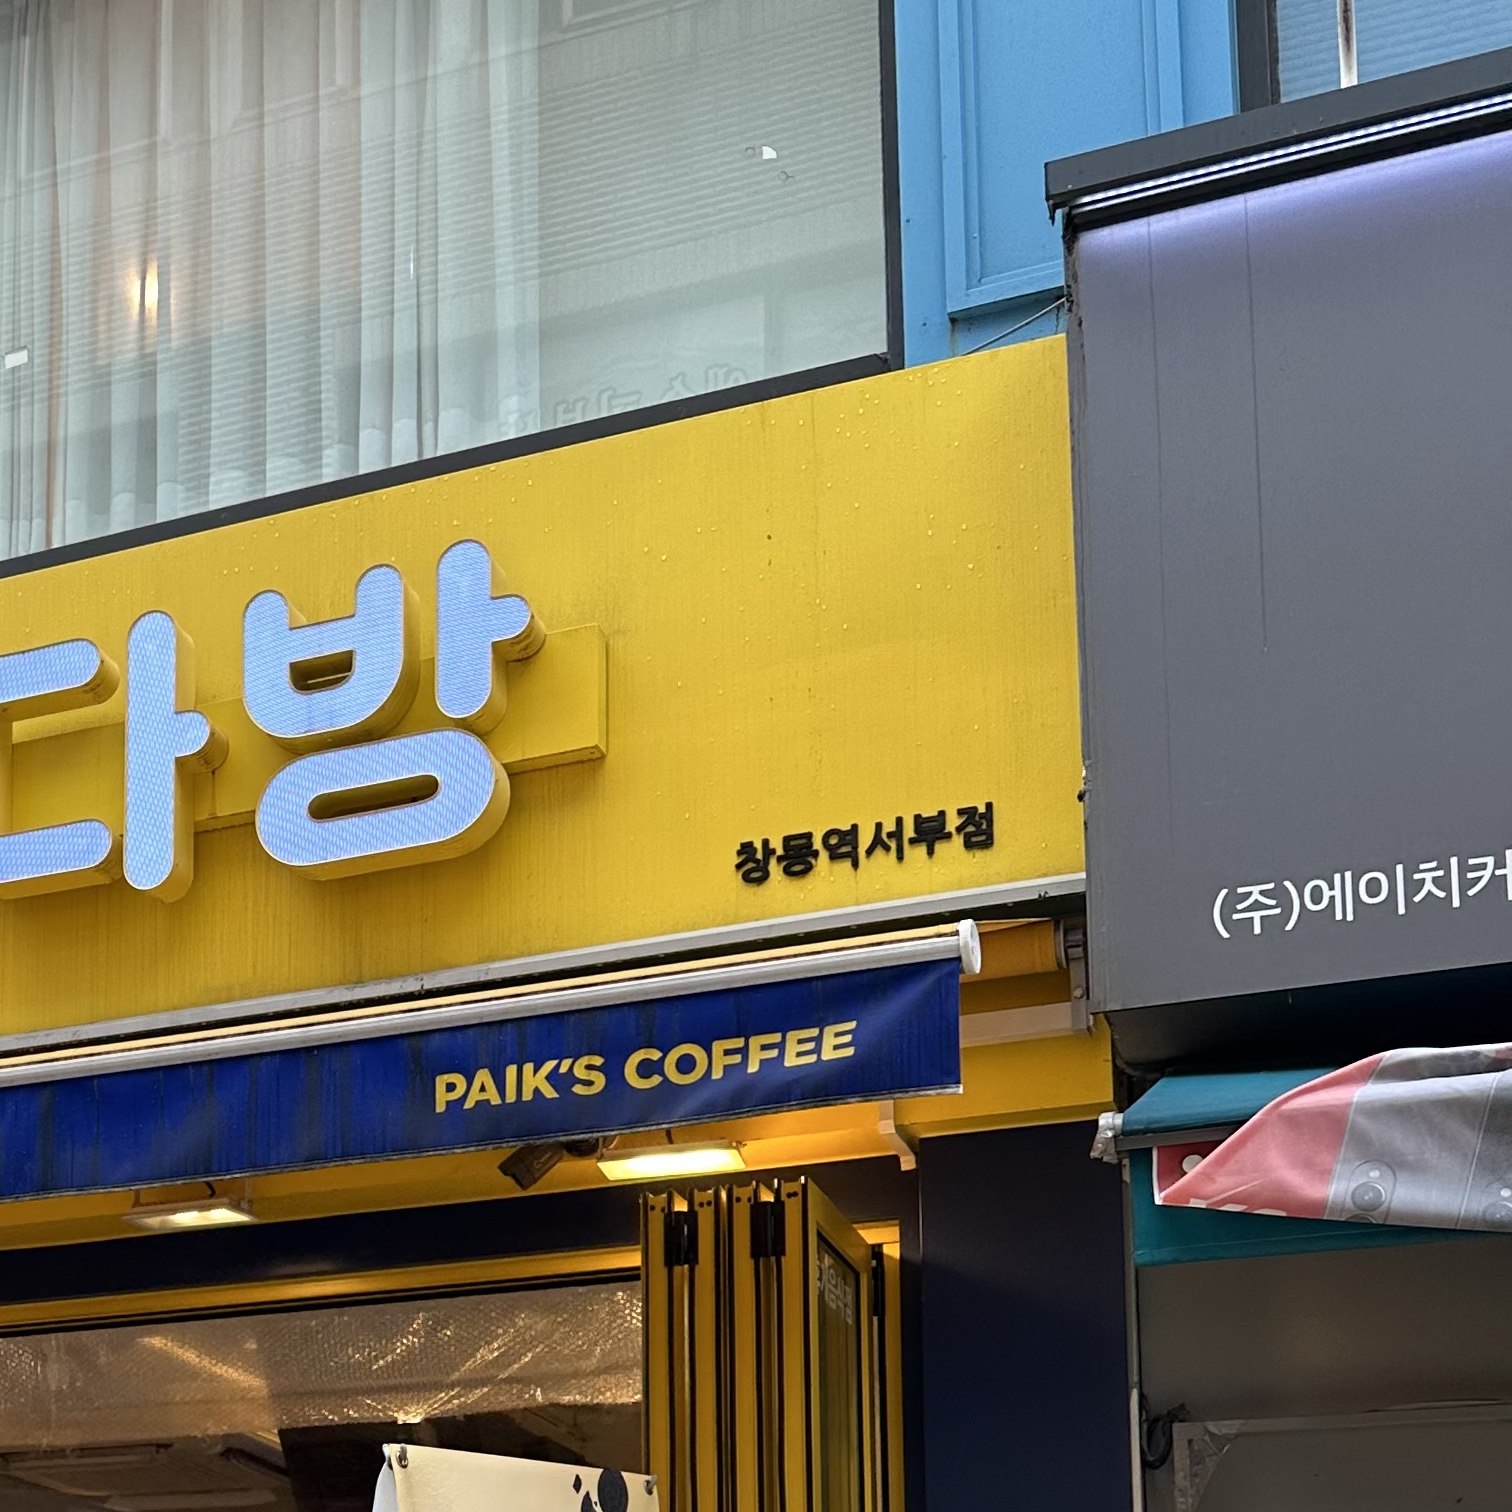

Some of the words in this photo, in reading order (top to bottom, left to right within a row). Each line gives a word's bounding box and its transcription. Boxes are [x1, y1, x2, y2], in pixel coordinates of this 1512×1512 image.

[735, 802, 994, 883] 창동역서부점
[435, 1055, 606, 1113] PAIK'S
[624, 1020, 857, 1090] COFFEE
